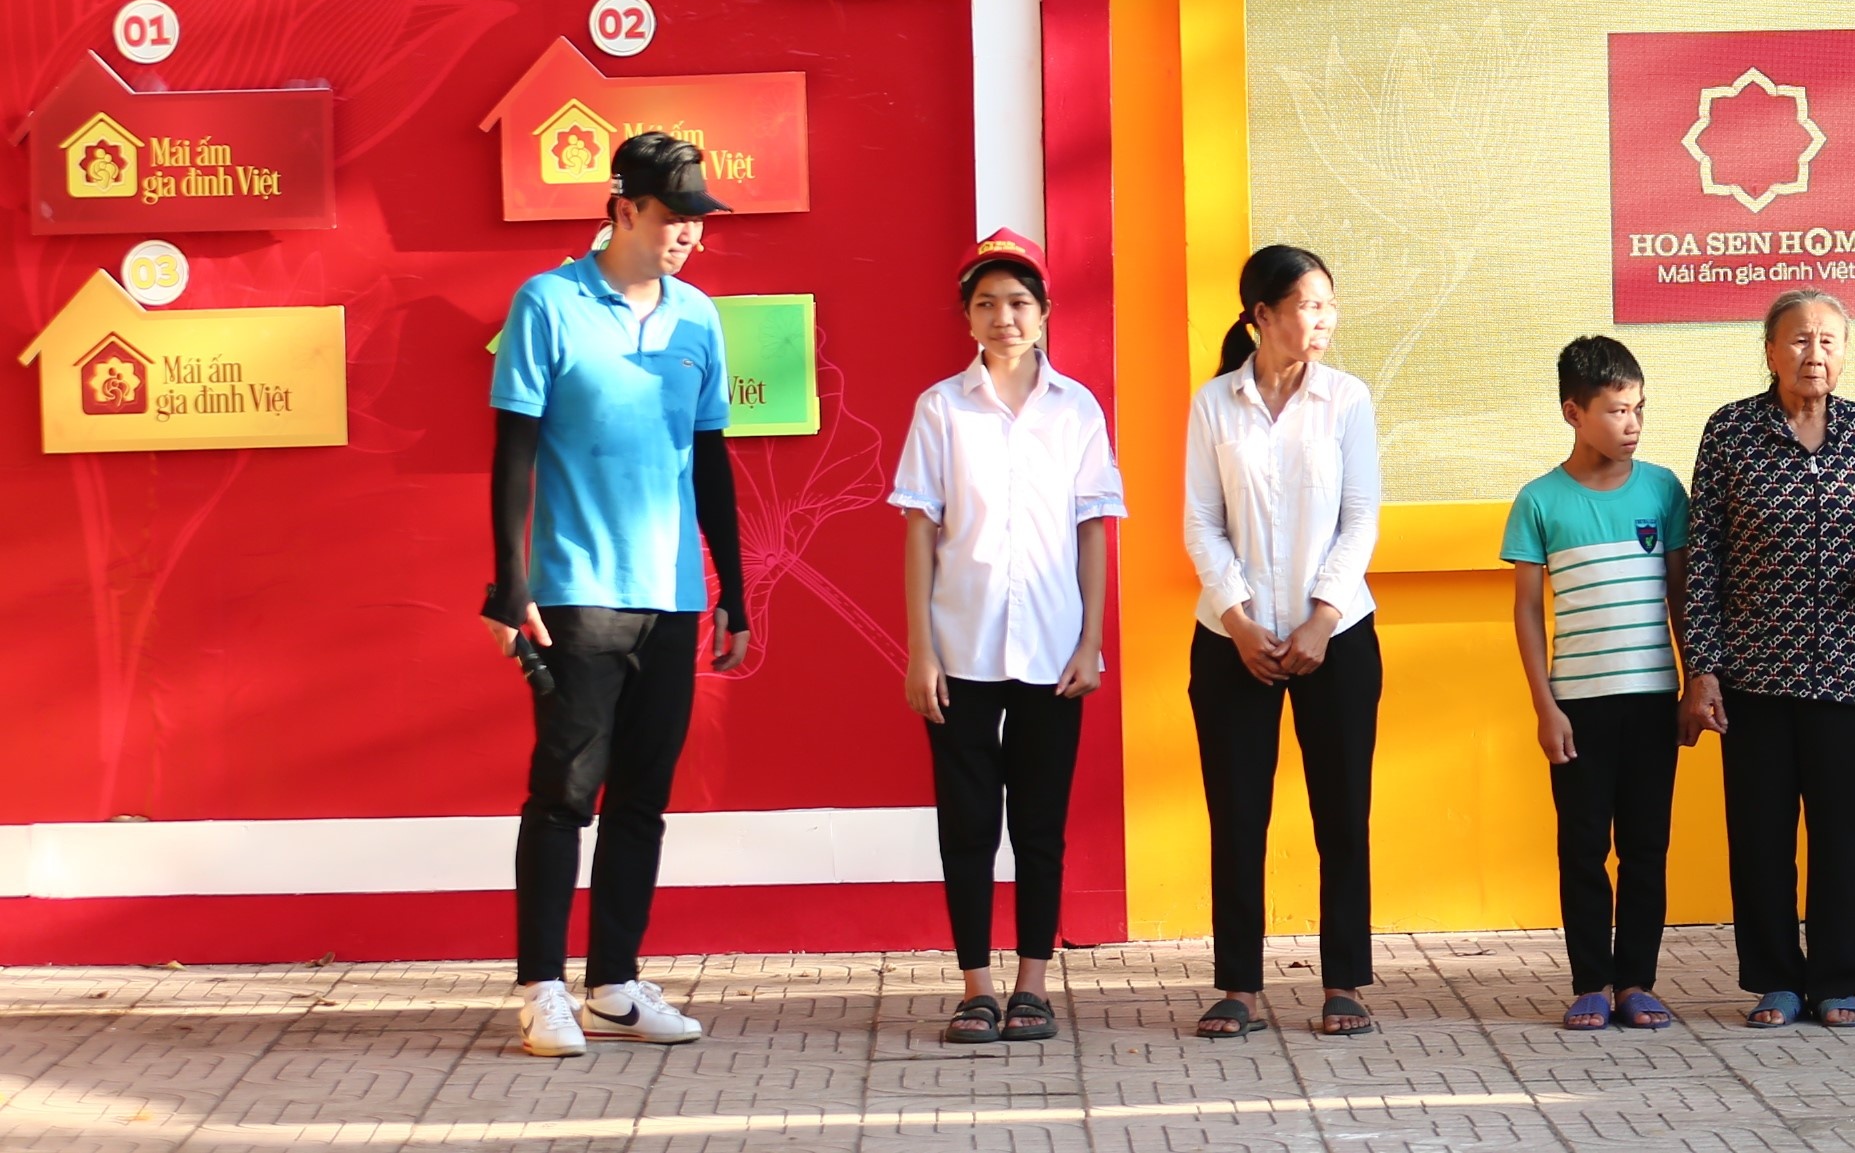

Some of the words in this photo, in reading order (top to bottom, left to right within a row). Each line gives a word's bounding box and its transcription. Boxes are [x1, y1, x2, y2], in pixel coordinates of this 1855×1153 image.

[122, 14, 172, 47] 01
[598, 8, 646, 40] 02
[149, 136, 192, 168] Mái
[195, 135, 232, 167] ấm
[709, 149, 756, 184] Việt
[141, 170, 177, 205] gia
[180, 166, 234, 197] đình
[235, 165, 282, 200] Việt
[1628, 232, 1702, 258] HOA
[1705, 230, 1774, 256] SEN
[130, 256, 180, 289] 03
[1657, 262, 1696, 283] Mái
[1697, 260, 1733, 283] ấm
[1735, 263, 1767, 286] gia
[1769, 261, 1813, 282] đình
[162, 354, 203, 385] Mái
[208, 353, 243, 384] ấm
[155, 389, 188, 423] gia
[193, 383, 246, 415] đình
[247, 383, 293, 416] Việt
[727, 375, 767, 409] Việt
